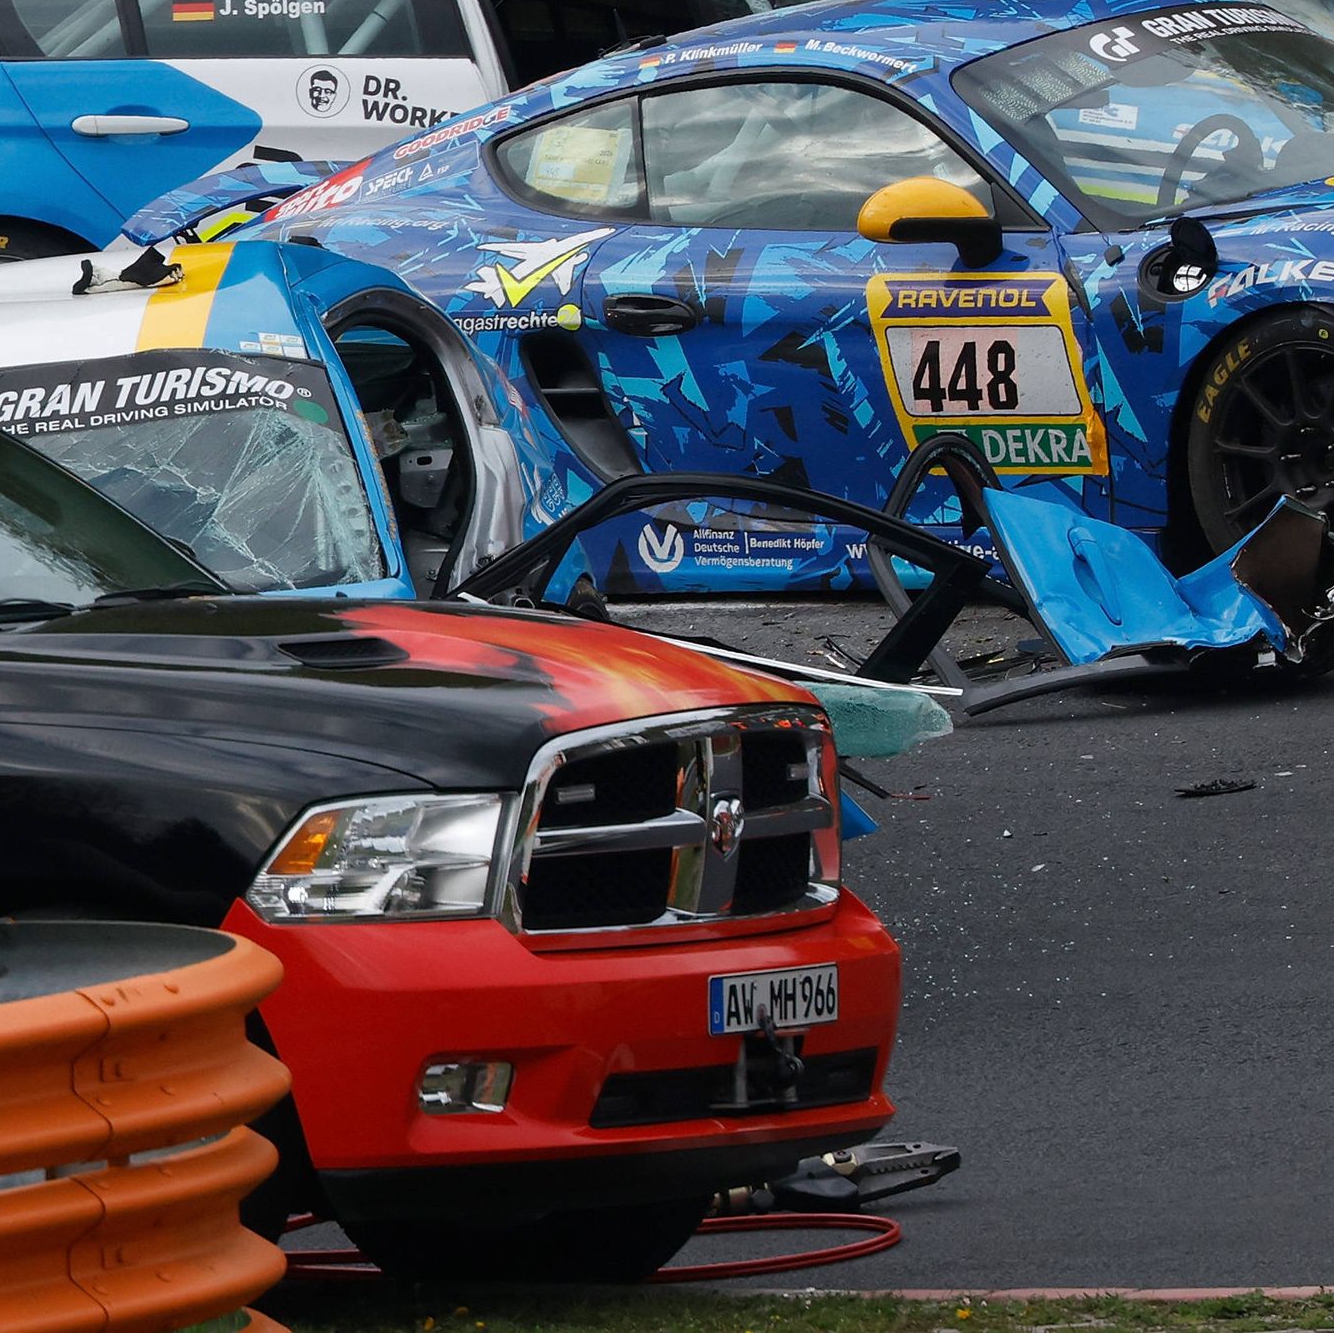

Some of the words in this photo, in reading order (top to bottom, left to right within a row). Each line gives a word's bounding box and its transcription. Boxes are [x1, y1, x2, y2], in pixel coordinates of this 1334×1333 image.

[219, 0, 239, 16] J.
[1141, 9, 1216, 38] GRAN
[1170, 35, 1191, 46] THE
[1190, 30, 1222, 43] REAL
[664, 52, 677, 64] P.
[679, 41, 763, 63] Klinkmüller
[362, 74, 408, 101] DR.
[393, 105, 511, 160] GOODRIDGE
[897, 288, 1037, 309] RAVENOL
[115, 367, 295, 409] TURISMO
[913, 340, 1019, 413] 448
[1196, 338, 1253, 425] EAGLE
[35, 417, 85, 434] REAL
[90, 406, 168, 427] DRIVING
[174, 396, 288, 416] SIMULATOR
[981, 427, 1094, 464] DEKRA
[693, 529, 735, 540] Allfinanz
[750, 537, 792, 549] Benedikt
[793, 537, 825, 551] Höpfer
[694, 542, 740, 554] Deutsche
[694, 555, 794, 570] Vermögensberatung
[727, 982, 755, 1027] AW
[770, 977, 797, 1021] MH
[802, 973, 836, 1019] 966
